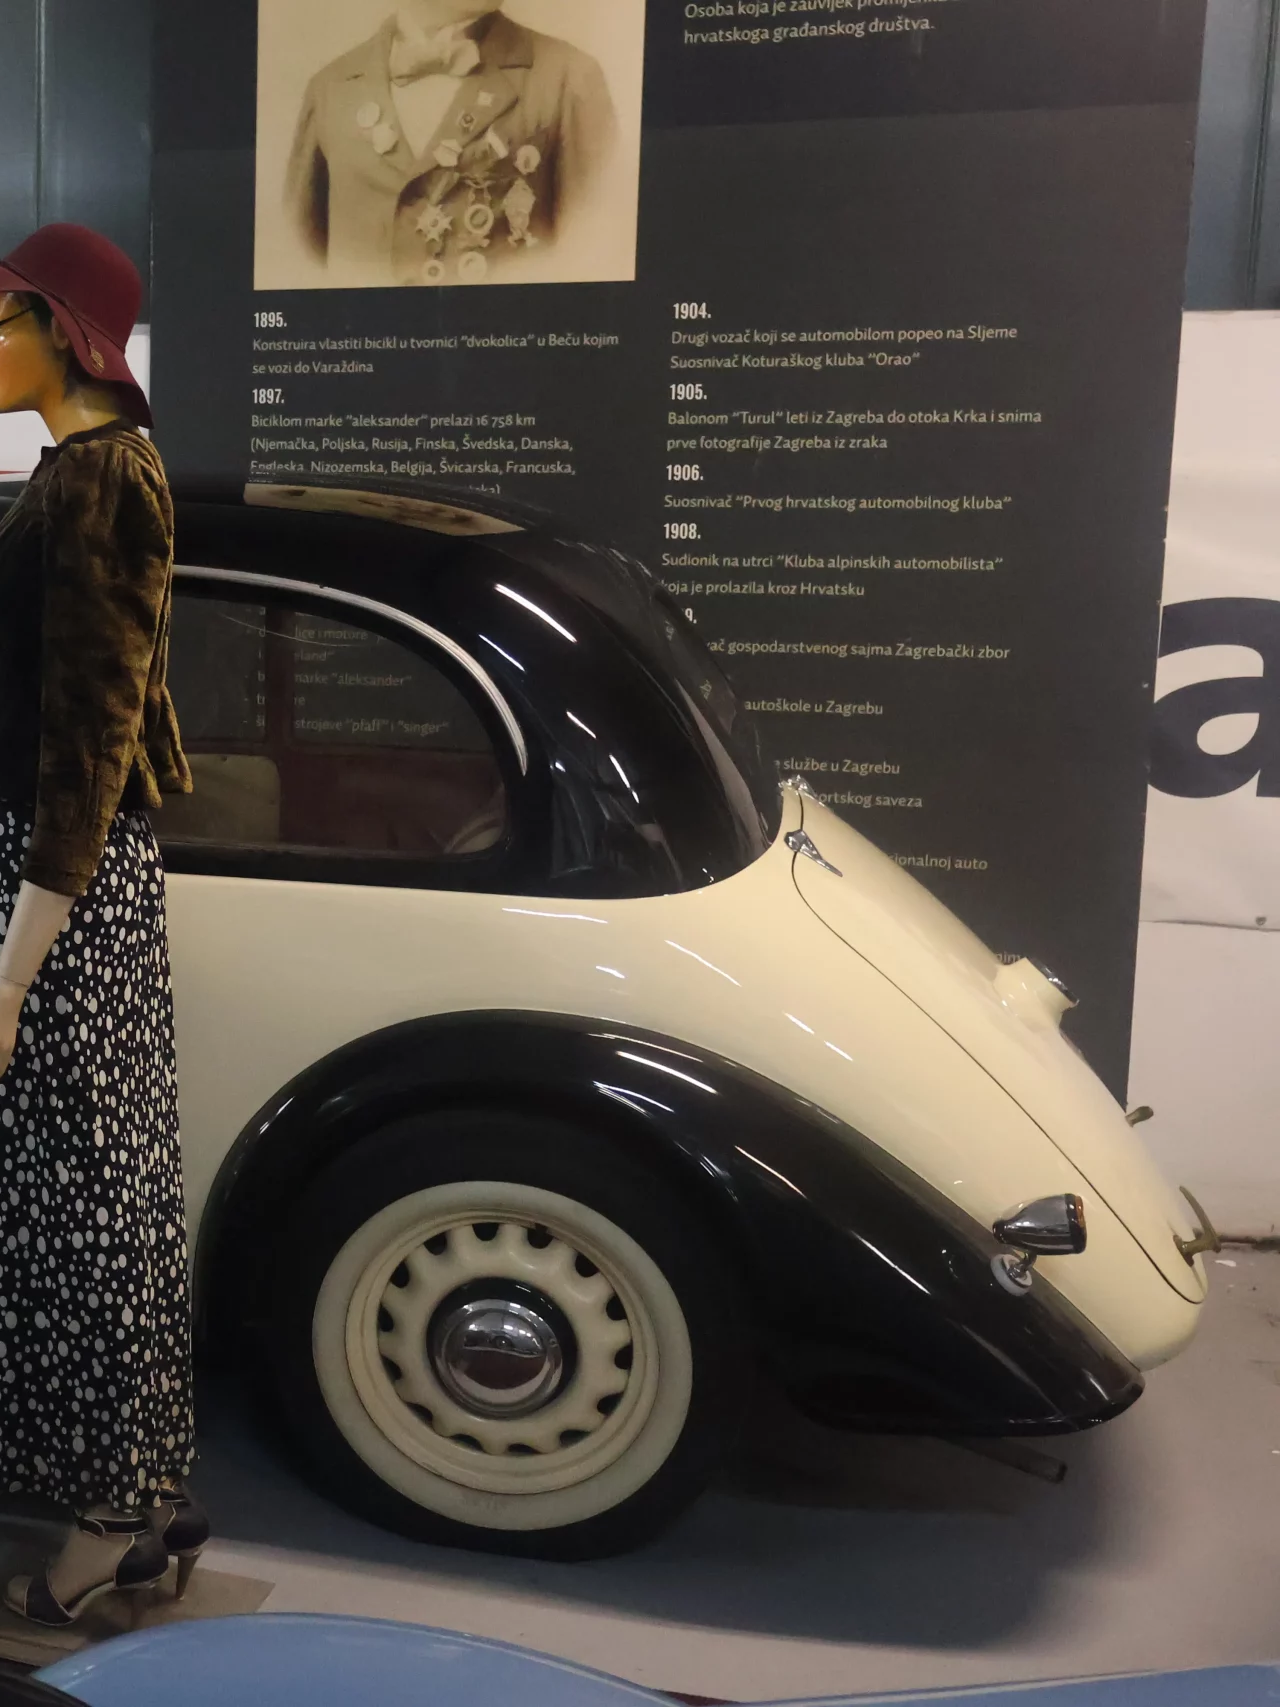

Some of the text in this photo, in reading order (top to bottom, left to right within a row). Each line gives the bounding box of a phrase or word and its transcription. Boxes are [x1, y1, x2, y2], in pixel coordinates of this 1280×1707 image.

[685, 2, 734, 18] Osoba
[738, 1, 769, 17] koja
[772, 0, 786, 16] je
[684, 16, 934, 44] hrvatskoga građanskog društva.
[254, 312, 287, 327] 1895.
[674, 303, 711, 319] 1904.
[253, 333, 619, 350] Konstruira vlastiti bicikl u tvornici "dvokolica" u Beču kojim
[672, 325, 1017, 347] Drugi vozač koji se automobilom popeo na Sljeme
[252, 360, 373, 374] se vozi do Varaždina
[671, 352, 920, 370] Suosnivač Koturaškog kluba "Orao"
[253, 389, 284, 404] 1897.
[670, 384, 707, 400] 1905.
[252, 413, 535, 429] Biciklom marke "aleksander" prelazi 16 758 km
[668, 409, 1041, 427] Balonom "Turul" leti iz Zagreba do otoka Krka i snima
[251, 434, 573, 452] (Njemačka, Poljska, Rusija, Finska, Švedska, Danska,
[667, 435, 887, 452] prve fotografije Zagreba iz zraka
[311, 461, 387, 475] Nizozemska,
[391, 461, 436, 476] Belgija,
[440, 457, 503, 475] Švicarska,
[506, 461, 575, 475] Francuska,
[666, 465, 703, 481] 1906.
[664, 495, 1011, 512] Suosnivač "Prvog hrvatskog automobilnog kluba"
[664, 523, 700, 539] 1908.
[662, 553, 1003, 570] Sudionik na utrci "Kluba alpinskih automobilista"
[691, 581, 703, 595] je
[706, 581, 764, 595] prolazila
[768, 582, 797, 594] kroz
[800, 582, 864, 595] Hrvatsku
[728, 640, 848, 658] gospodarstvenog
[851, 644, 892, 658] sajma
[895, 643, 974, 659] Zagrebački
[978, 645, 1010, 658] zbor
[745, 698, 883, 717] autoškole u Zagrebu
[784, 758, 827, 771] službe
[831, 763, 839, 771] u
[842, 759, 900, 776] Zagrebu
[815, 792, 922, 808] ortskog saveza
[955, 858, 987, 869] auto
